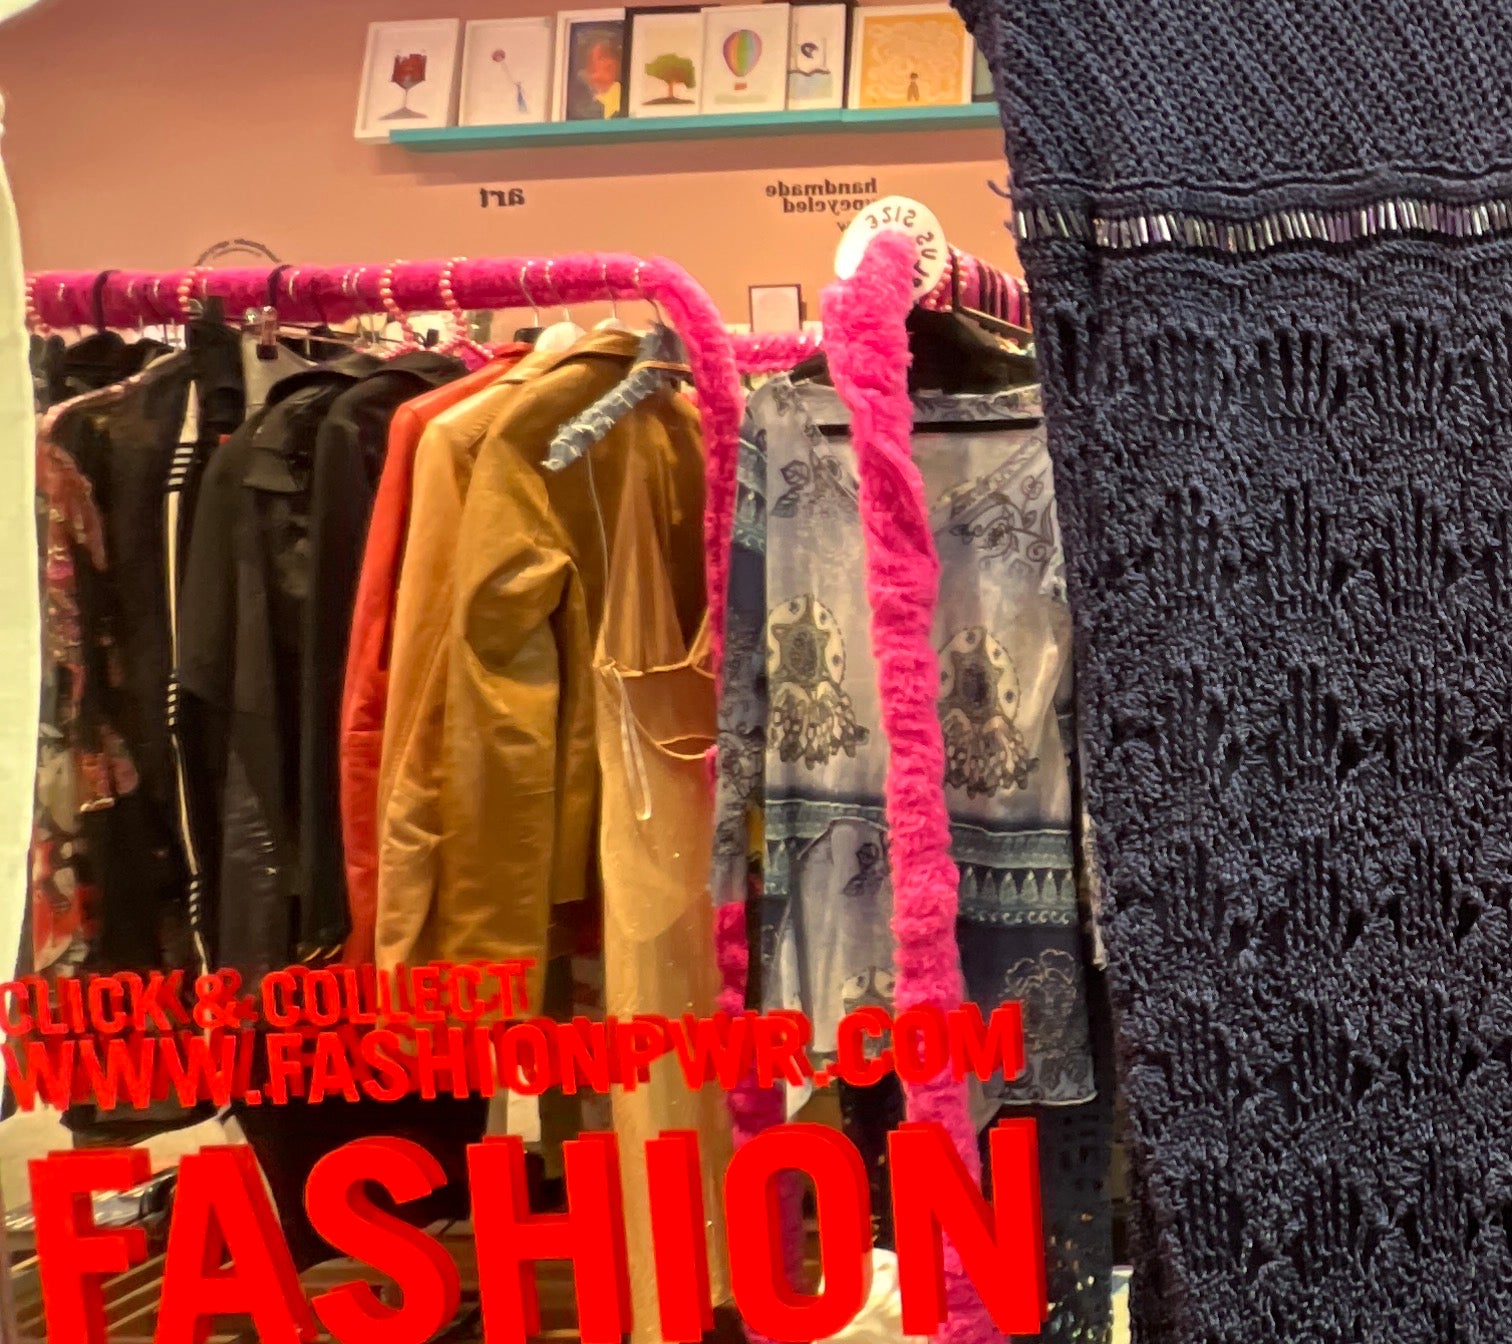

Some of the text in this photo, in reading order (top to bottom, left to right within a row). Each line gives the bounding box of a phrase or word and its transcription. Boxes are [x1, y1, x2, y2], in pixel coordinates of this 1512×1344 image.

[0, 961, 530, 1035] CLICK & COLLECT
[0, 1001, 1023, 1112] WWW.FASHIONPWR.COM
